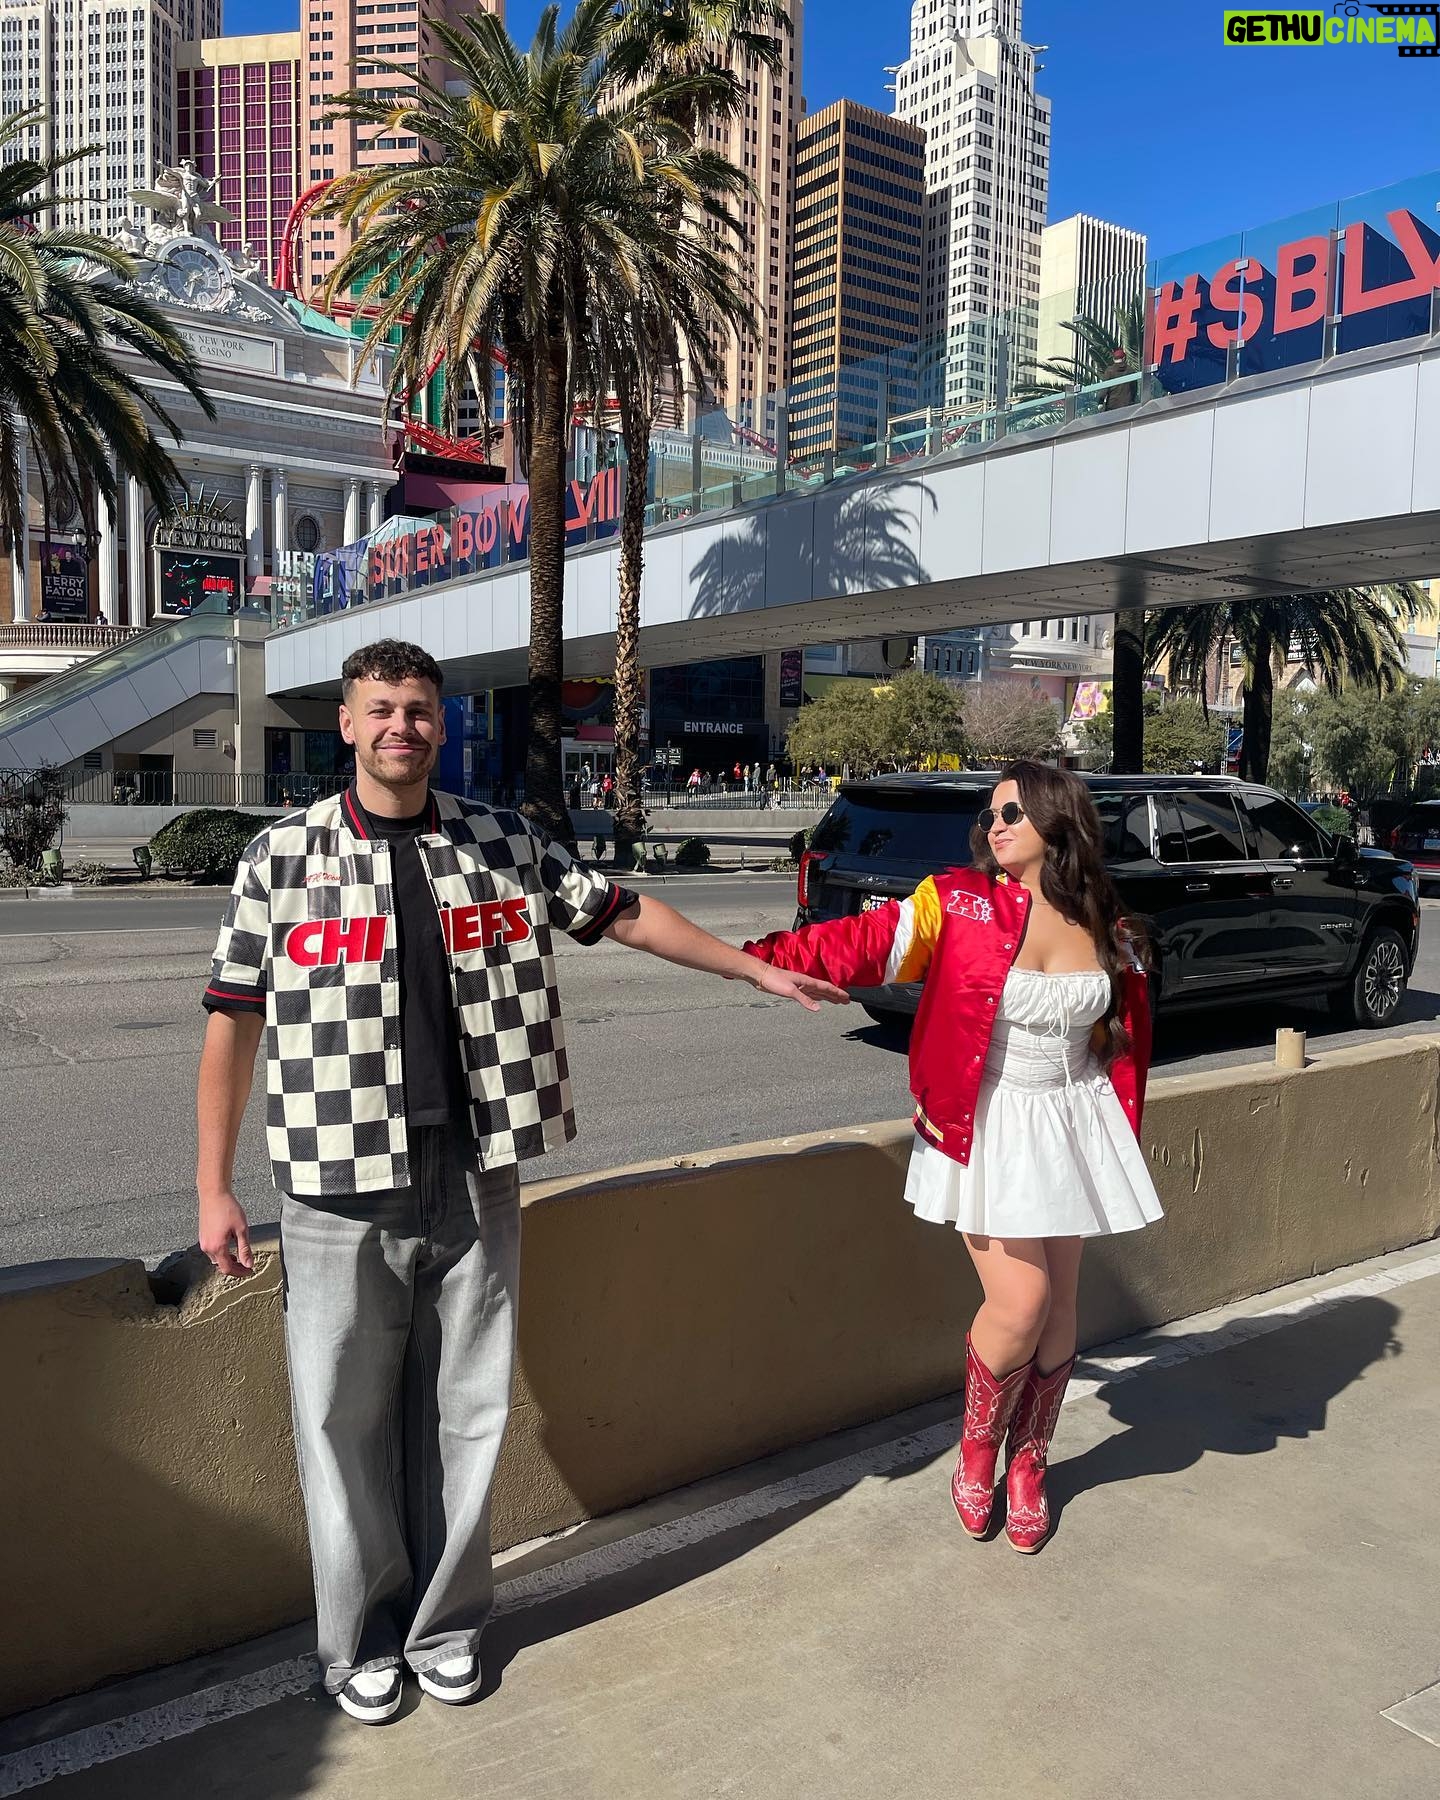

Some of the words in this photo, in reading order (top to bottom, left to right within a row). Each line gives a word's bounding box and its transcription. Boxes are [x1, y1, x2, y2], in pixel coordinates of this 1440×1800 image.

[199, 335, 217, 345] NEW
[221, 339, 245, 351] YORK
[200, 346, 232, 358] CASINO
[200, 518, 242, 536] YORK
[458, 494, 529, 559] BOW
[160, 529, 198, 546] NEW
[200, 532, 244, 552] YORK
[45, 575, 85, 588] TERRY
[46, 586, 84, 598] FATOR
[684, 721, 744, 734] ENTRANCE
